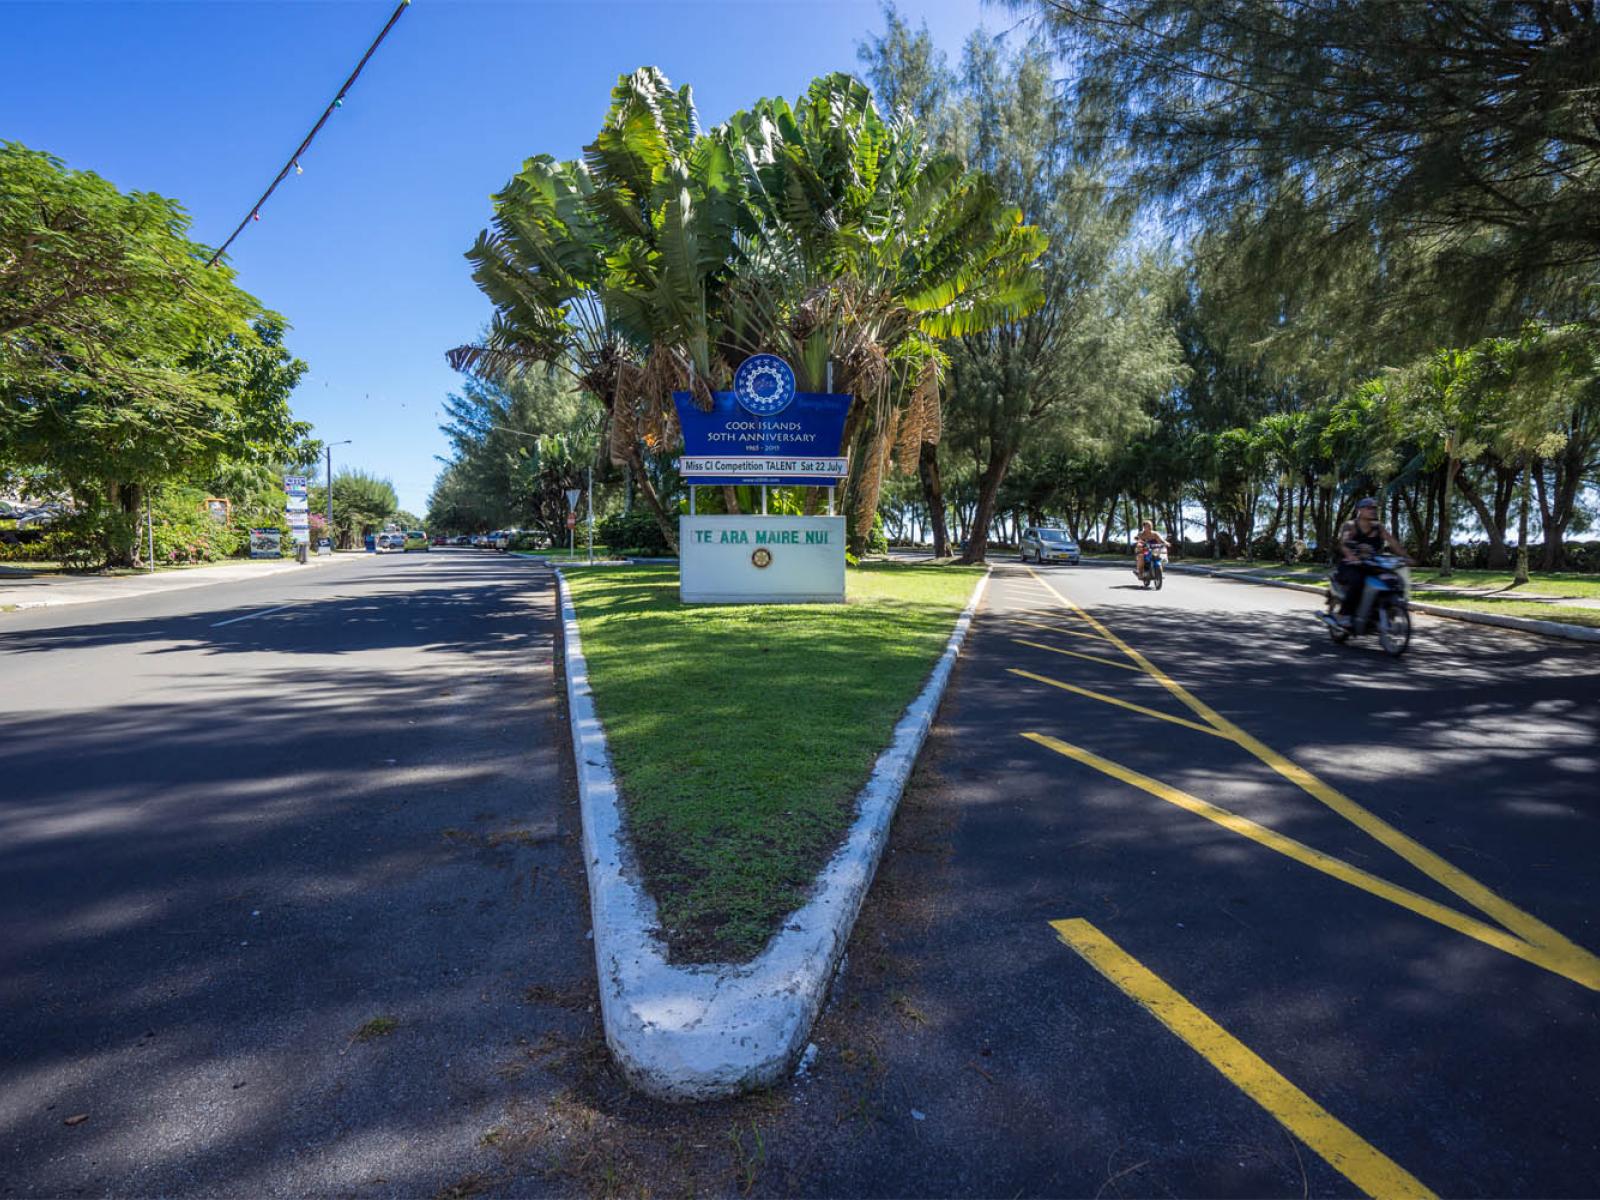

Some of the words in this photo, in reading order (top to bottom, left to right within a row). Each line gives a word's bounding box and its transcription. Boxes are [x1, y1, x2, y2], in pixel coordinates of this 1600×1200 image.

[725, 421, 755, 430] COOK
[758, 421, 801, 430] ISLANDS
[707, 432, 736, 441] 50TH
[738, 432, 816, 442] ANNIVERSARY
[685, 460, 704, 471] Miss
[715, 460, 764, 473] Competition
[765, 461, 797, 471] TALENT
[800, 461, 814, 471] Sat
[815, 462, 825, 471] 22
[826, 462, 843, 474] July
[695, 530, 713, 544] TE
[720, 530, 749, 545] ARA
[755, 530, 800, 545] MAIRE
[805, 530, 829, 545] NUI
